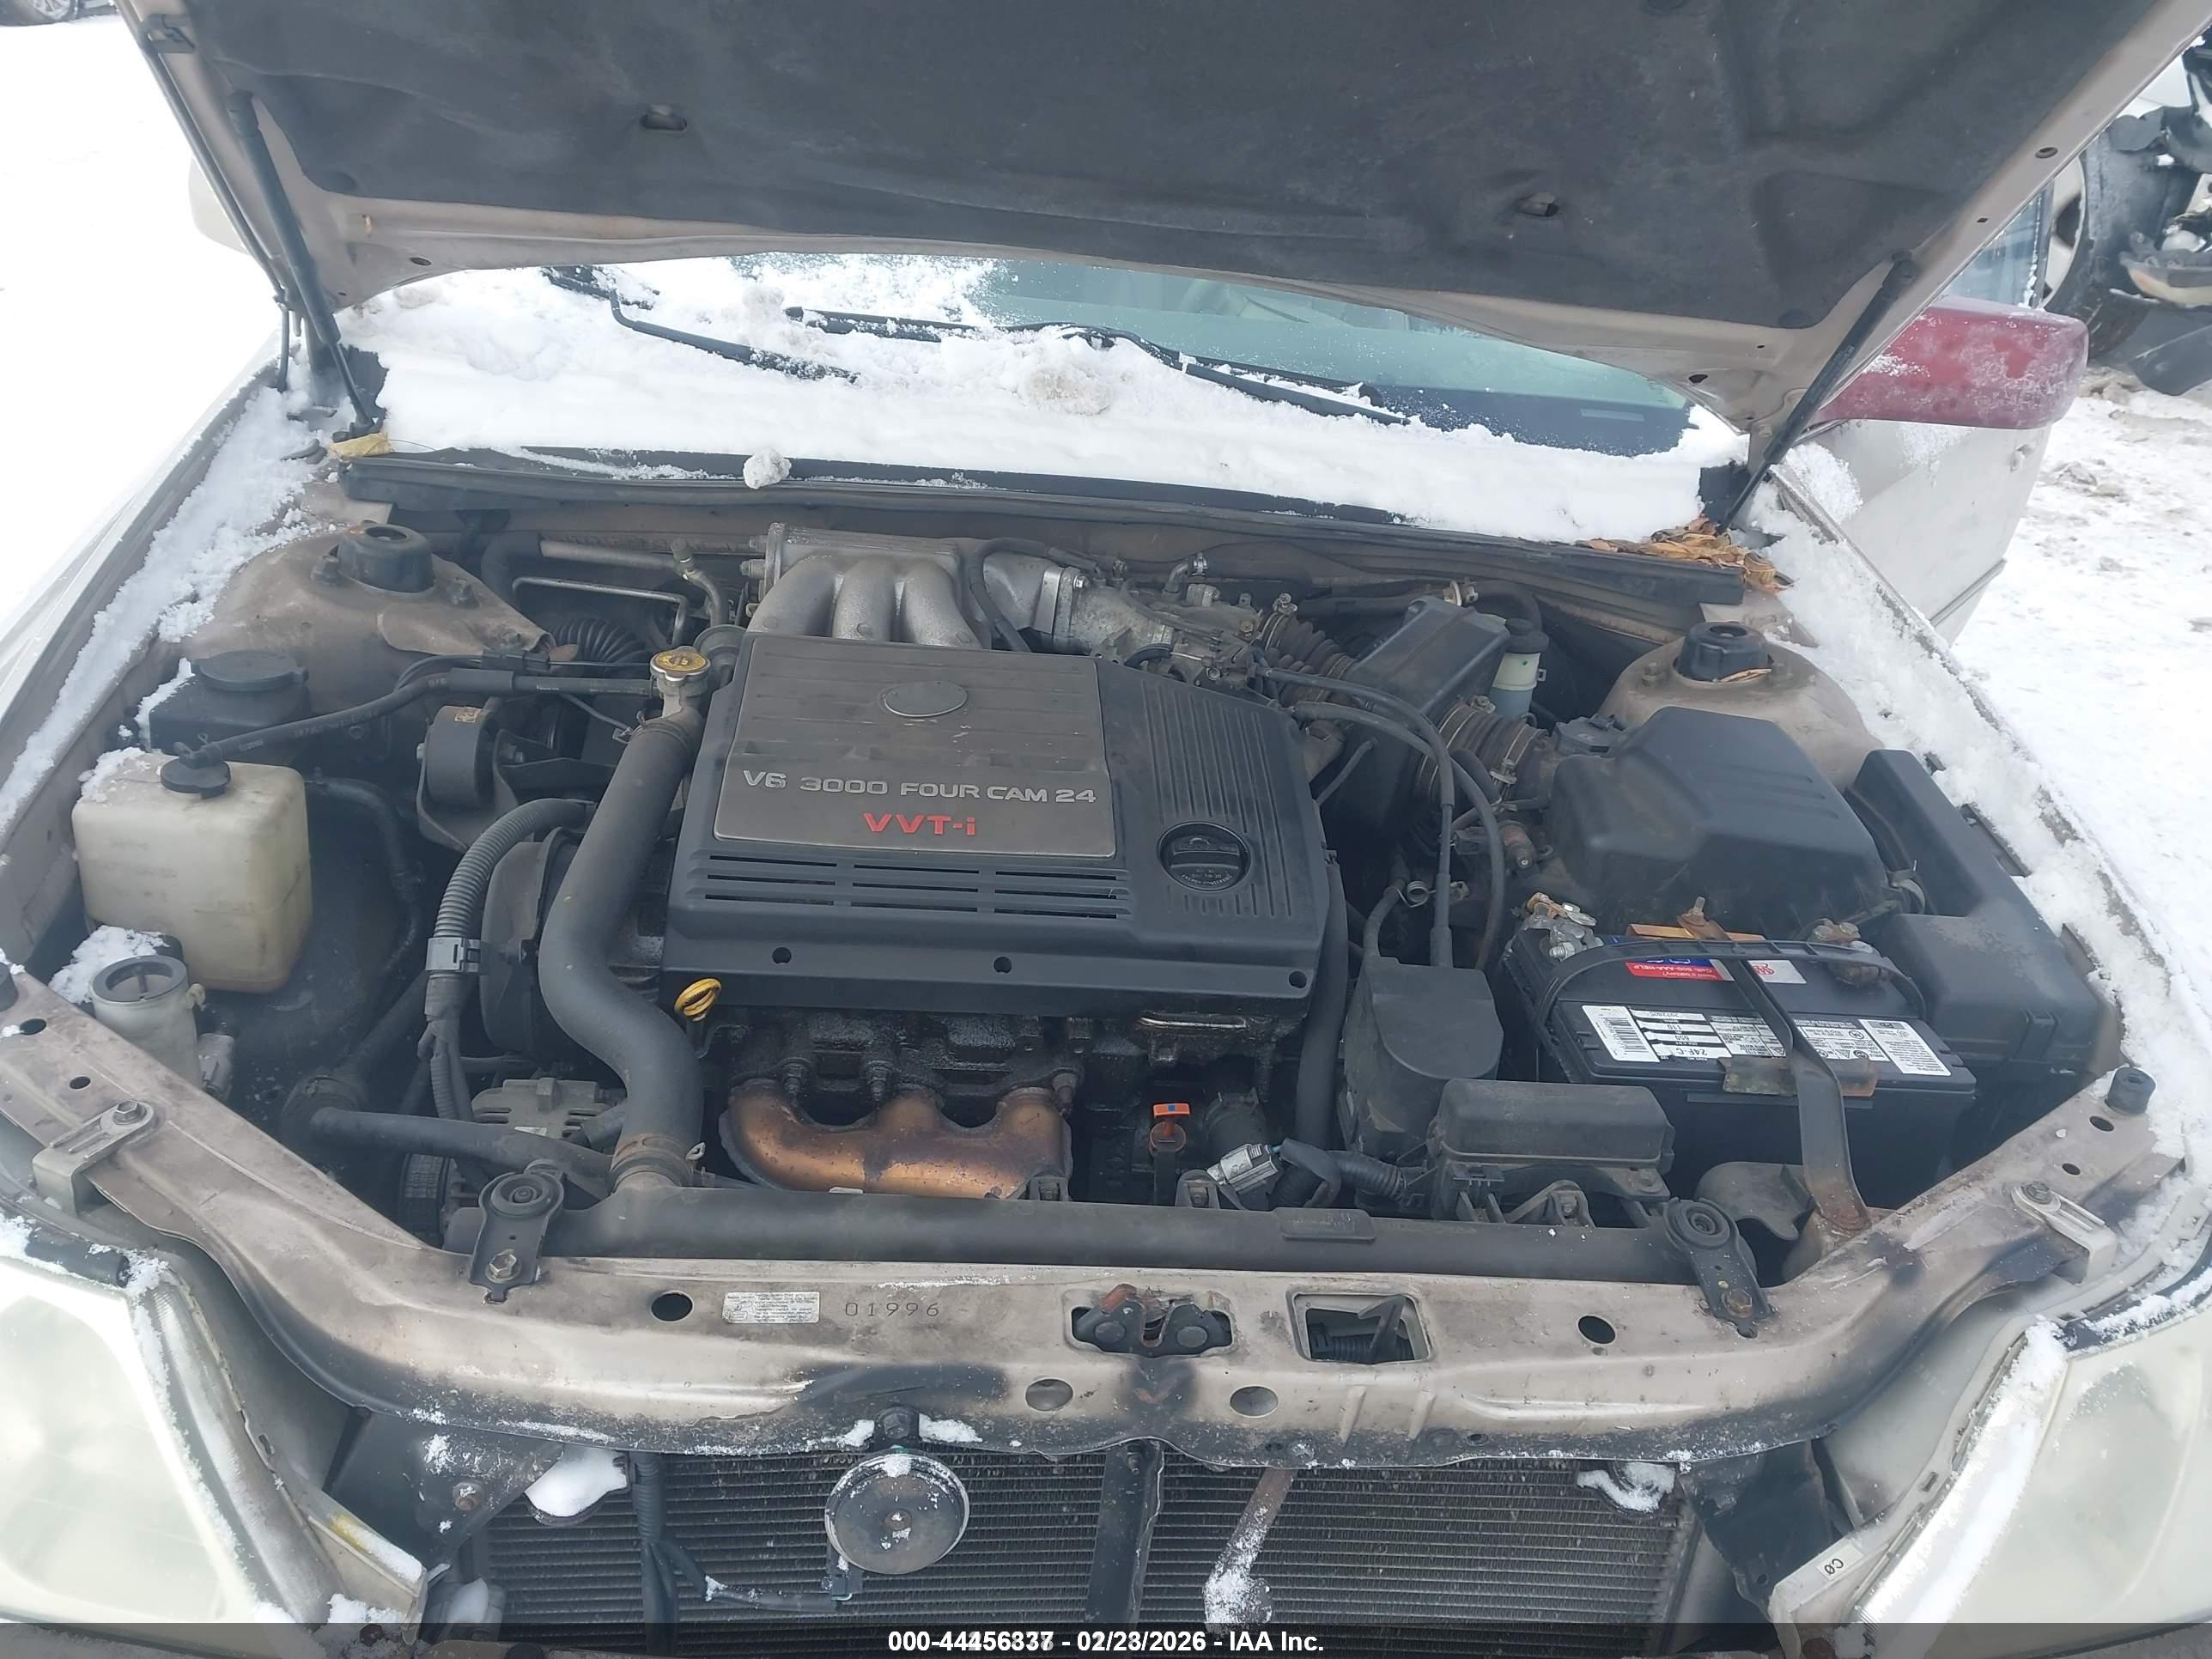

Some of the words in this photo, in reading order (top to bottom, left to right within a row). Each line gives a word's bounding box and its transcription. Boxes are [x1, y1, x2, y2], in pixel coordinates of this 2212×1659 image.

[742, 769, 787, 789] V6
[799, 776, 889, 796] 3000
[900, 781, 981, 800] FOUR
[987, 785, 1048, 804] CAM
[1055, 788, 1097, 805] 24
[864, 812, 977, 836] VVT-i
[1675, 1047, 1708, 1057] 24F-C
[844, 1302, 940, 1317] 01996
